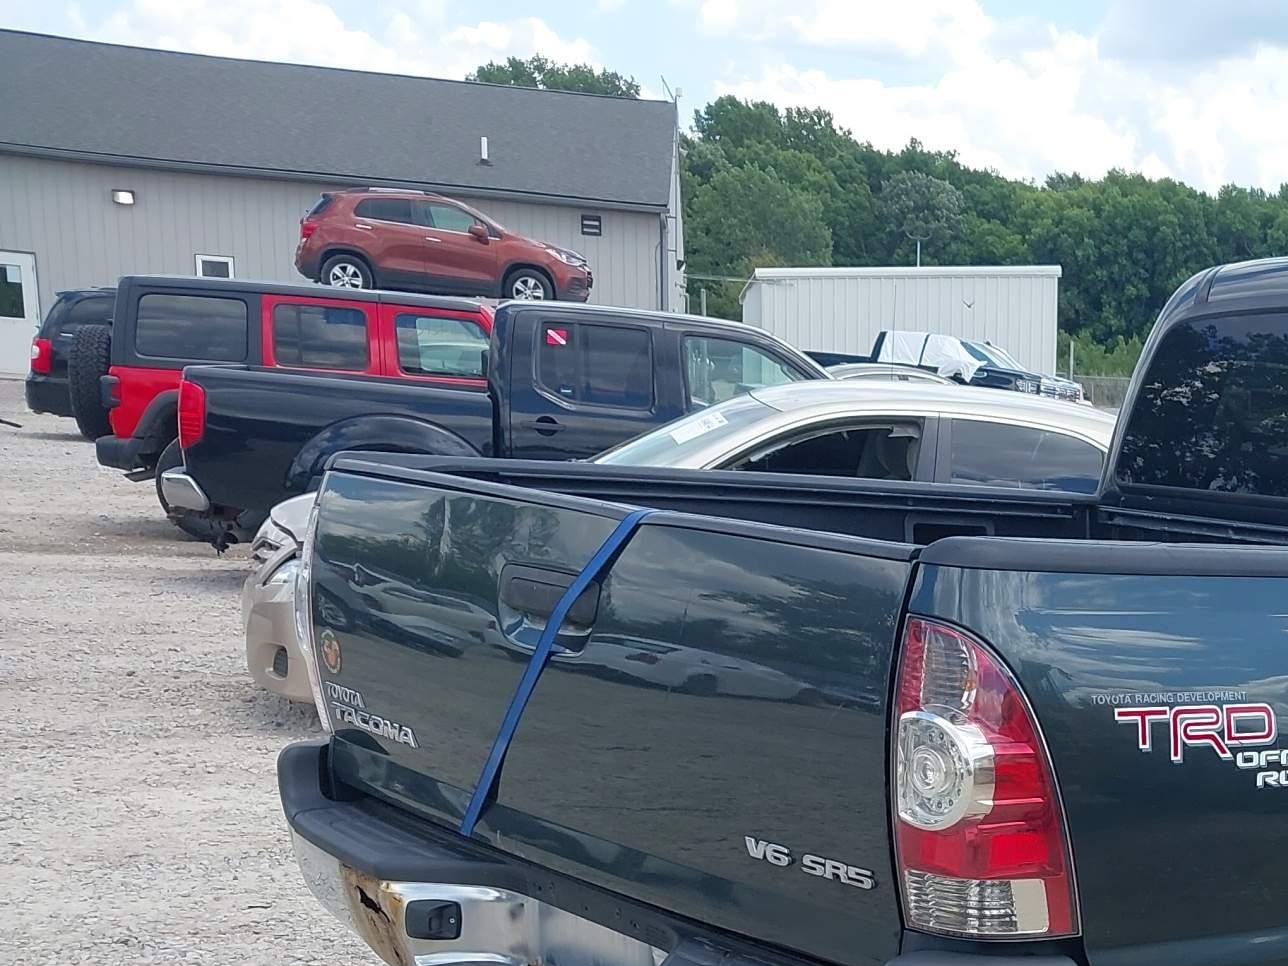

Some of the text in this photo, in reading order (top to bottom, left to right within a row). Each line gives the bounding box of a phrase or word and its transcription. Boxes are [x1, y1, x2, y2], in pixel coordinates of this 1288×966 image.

[325, 681, 366, 708] TOYOTA
[1091, 691, 1248, 705] TOYOTA RACING DEVELOPMENT
[331, 701, 419, 748] TACOMA
[1114, 702, 1278, 764] TRD
[744, 835, 875, 890] V6 SR5
